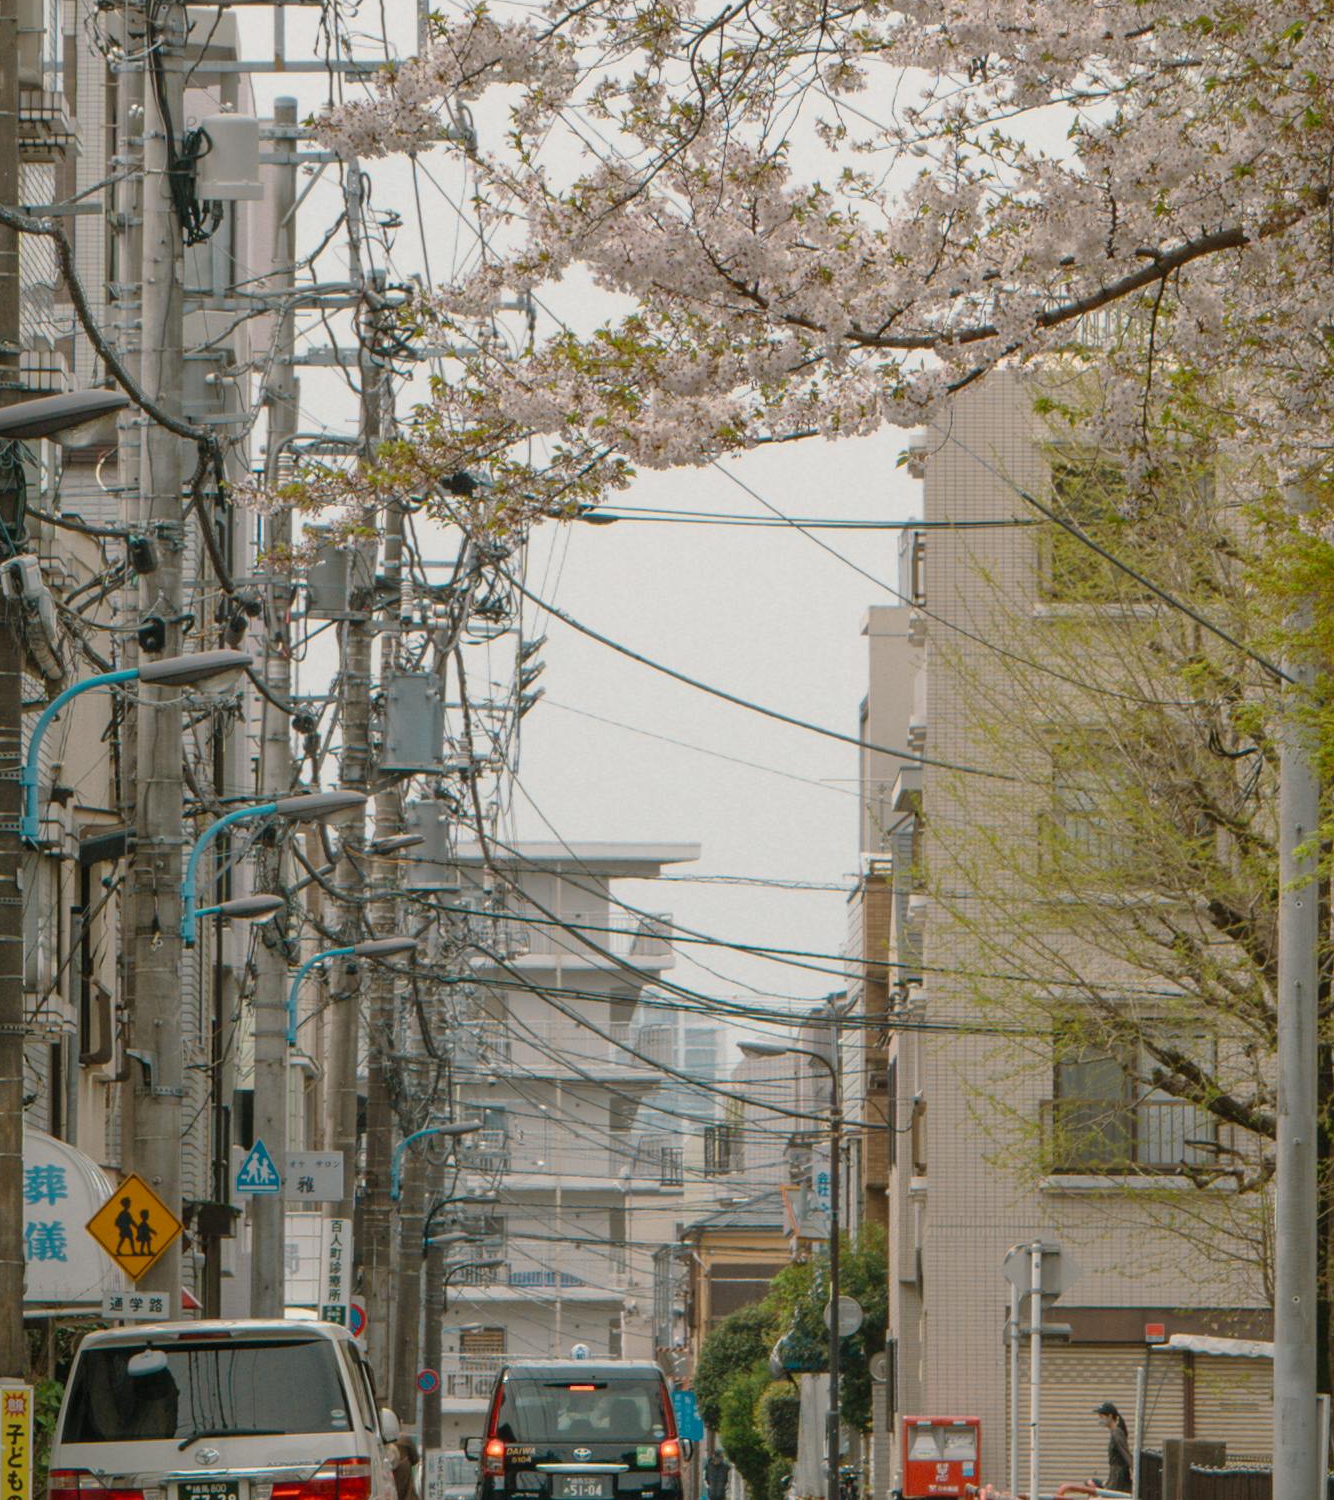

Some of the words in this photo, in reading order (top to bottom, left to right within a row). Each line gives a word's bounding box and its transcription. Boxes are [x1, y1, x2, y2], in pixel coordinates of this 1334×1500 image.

[24, 1164, 68, 1262] 葬儀
[327, 1219, 344, 1303] 百人町診療所
[109, 1296, 163, 1313] 通学路
[506, 1447, 537, 1456] DAIWA
[569, 1485, 602, 1497] 51-04
